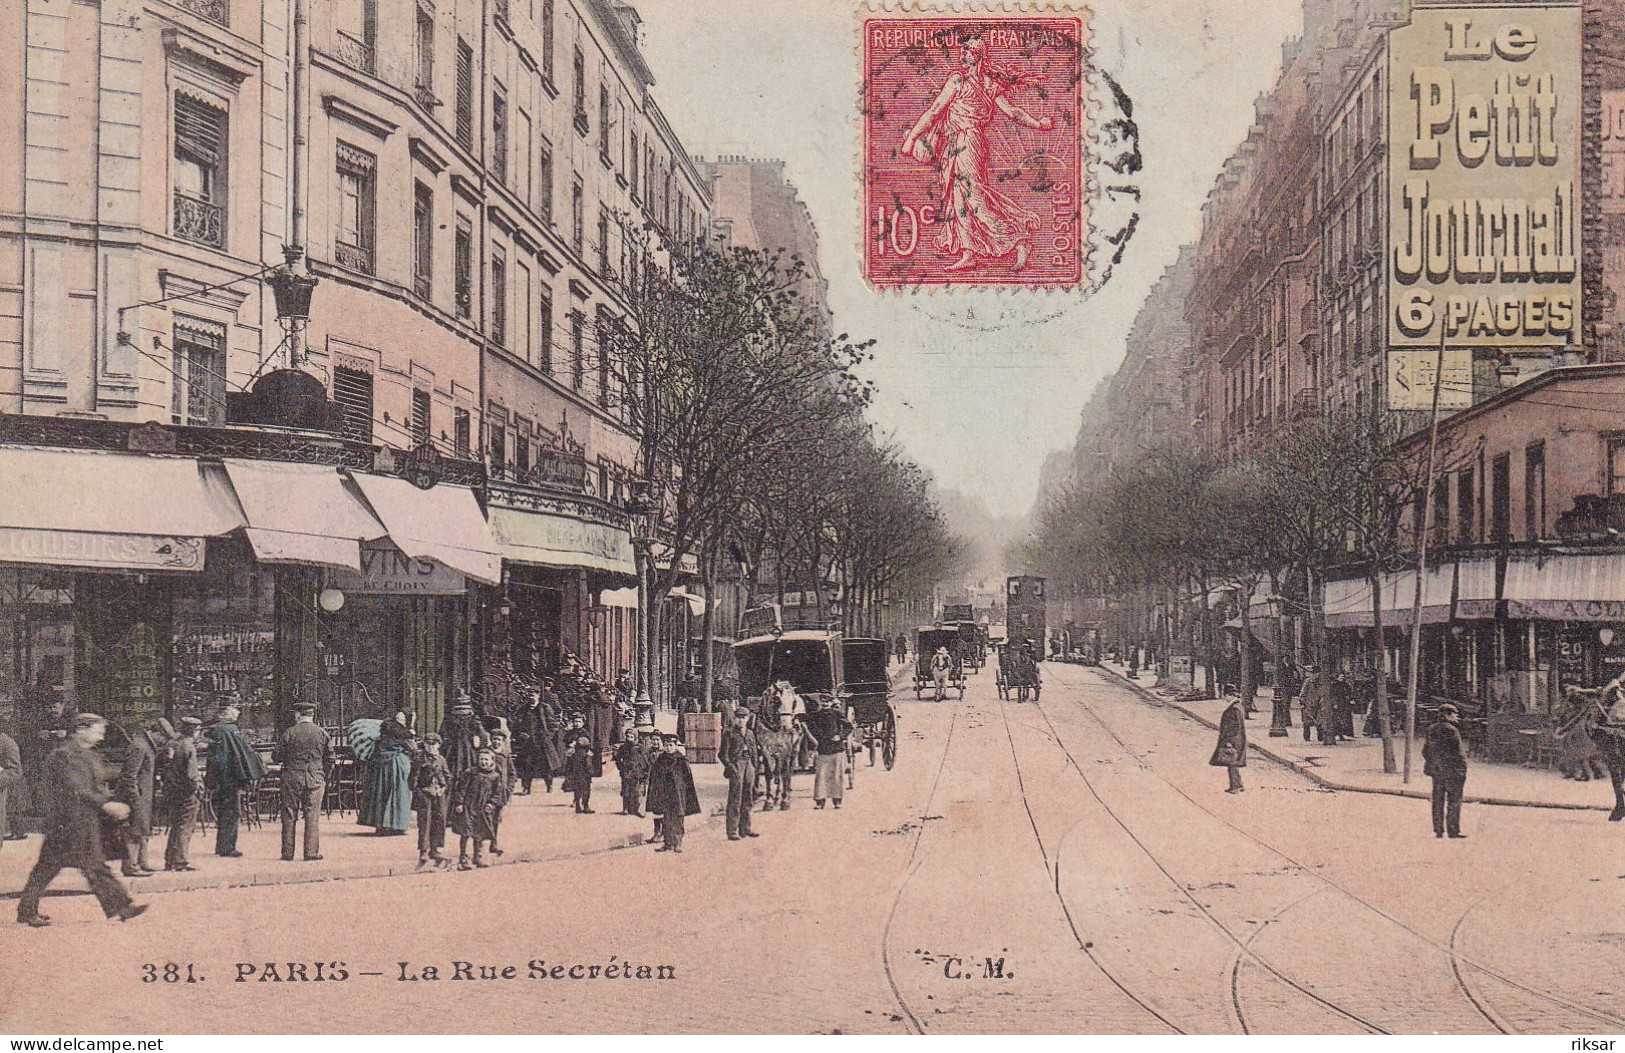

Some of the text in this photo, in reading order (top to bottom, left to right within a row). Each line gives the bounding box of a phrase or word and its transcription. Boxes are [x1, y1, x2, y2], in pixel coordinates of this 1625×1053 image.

[1443, 18, 1537, 62] Le
[1409, 66, 1558, 170] Petit
[1052, 182, 1070, 265] POSTES
[1394, 178, 1576, 285] Journal
[1396, 288, 1573, 338] 6 PAGES
[0, 531, 141, 560] IQUEURS
[360, 549, 435, 576] VINS
[1560, 641, 1582, 656] 20
